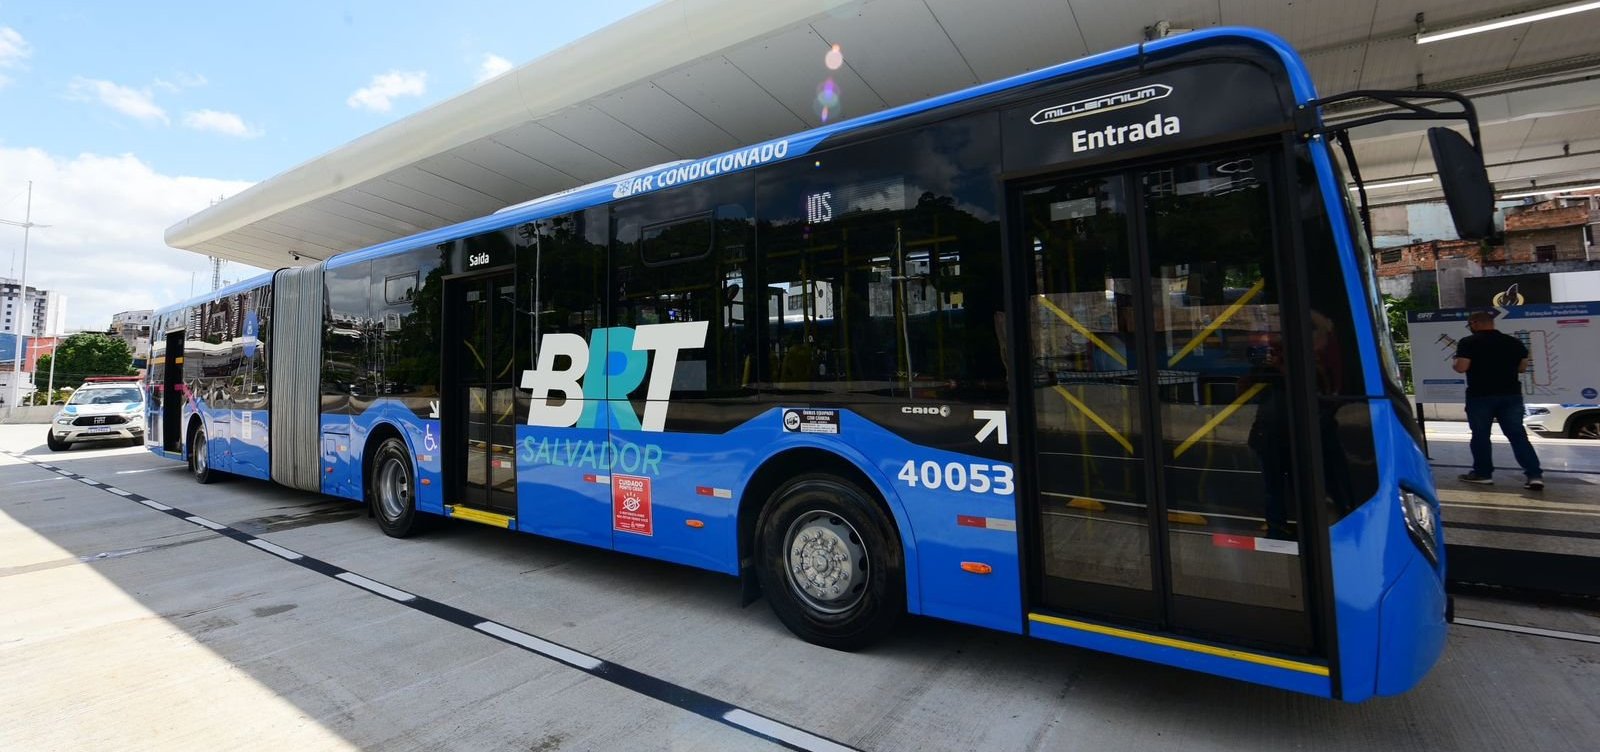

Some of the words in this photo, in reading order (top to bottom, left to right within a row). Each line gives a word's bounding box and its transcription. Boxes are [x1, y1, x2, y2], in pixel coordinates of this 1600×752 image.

[1045, 88, 1156, 120] MILLENNIUM
[1072, 113, 1181, 153] Entrada
[632, 175, 652, 194] AR
[657, 140, 789, 188] CONDICIONADO
[469, 252, 490, 267] Saída
[520, 320, 710, 433] BRT
[901, 406, 940, 415] CAIO
[521, 435, 663, 476] SALVADOR
[897, 459, 1015, 495] 40053
